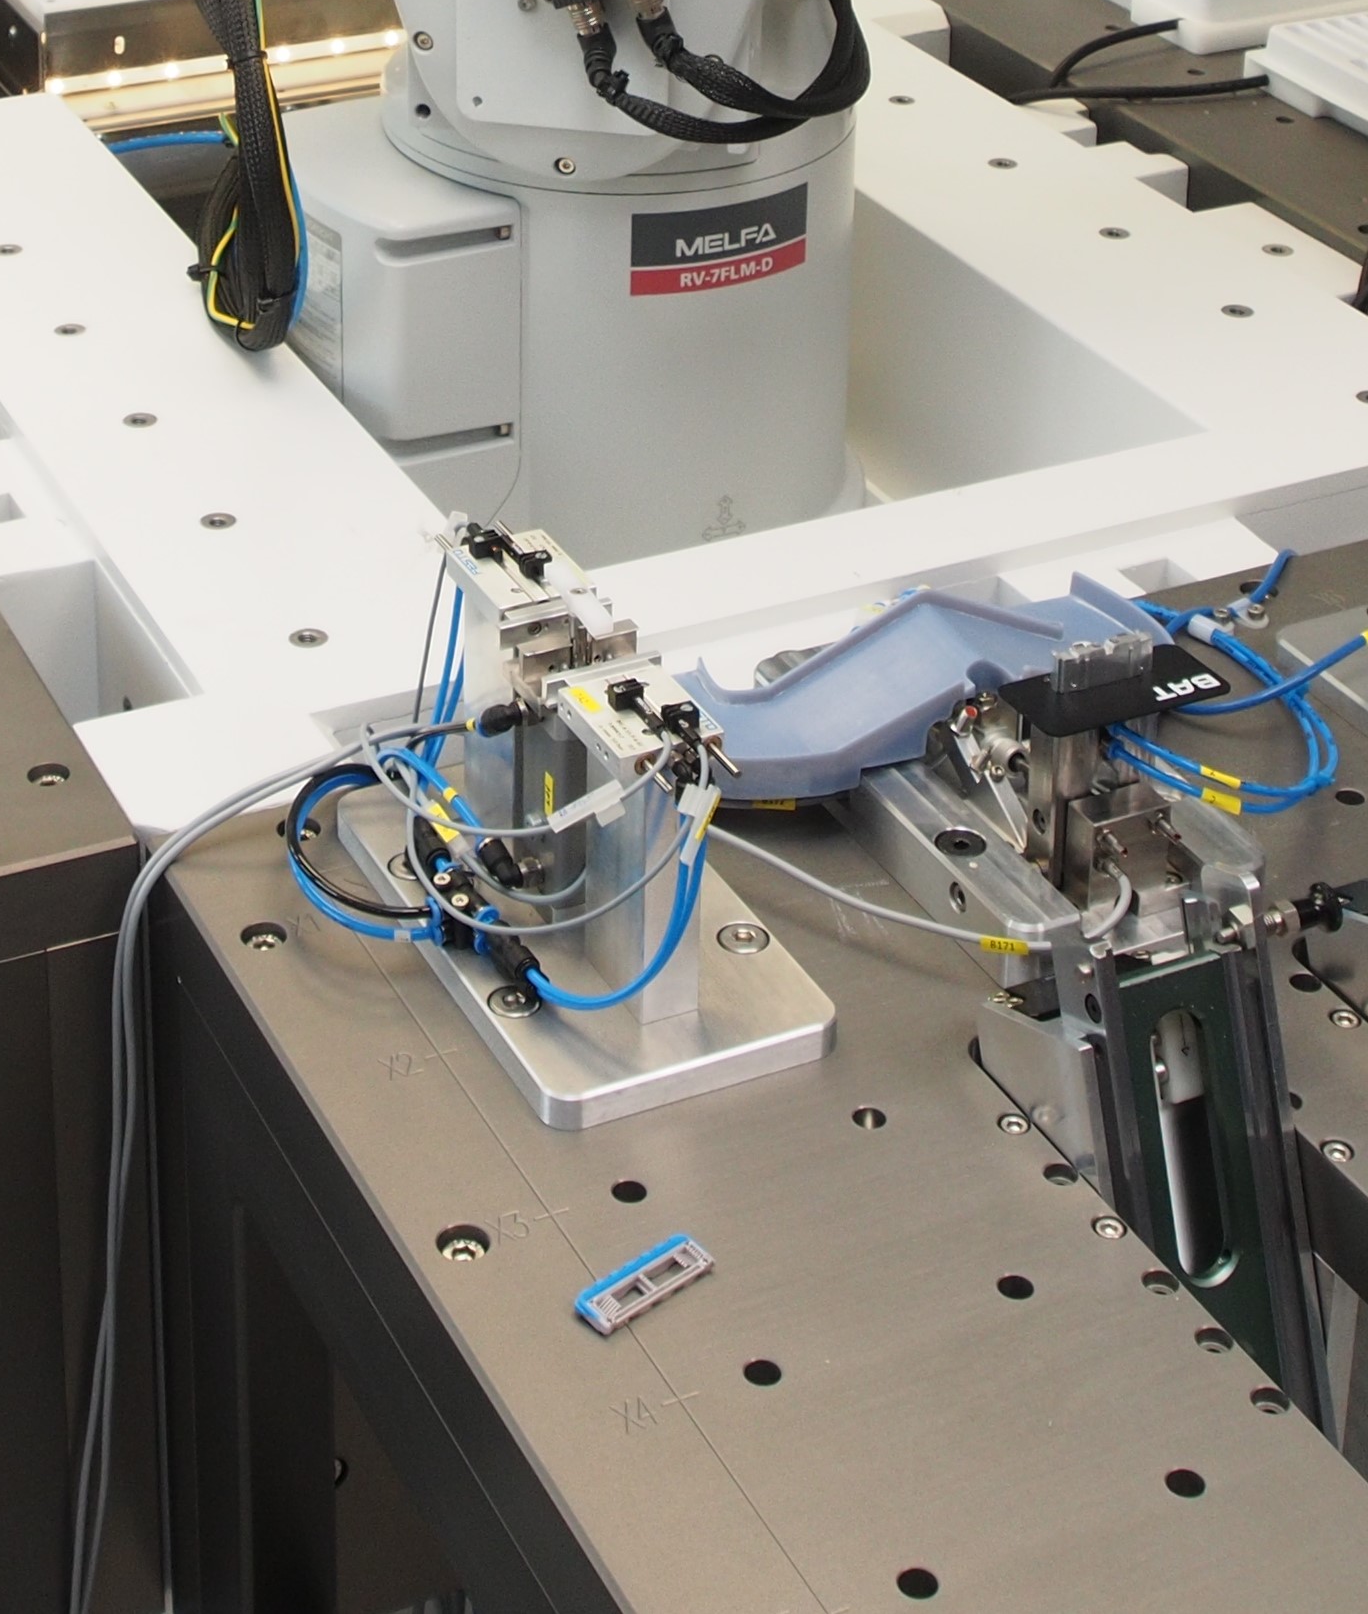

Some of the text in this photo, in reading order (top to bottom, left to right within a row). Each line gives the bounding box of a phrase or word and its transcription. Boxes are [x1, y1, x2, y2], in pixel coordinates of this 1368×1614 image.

[675, 222, 777, 258] MELFA
[679, 257, 774, 288] RV-7FLM-D
[1152, 672, 1222, 702] BAT
[484, 1210, 530, 1246] X3
[608, 1396, 658, 1435] X4
